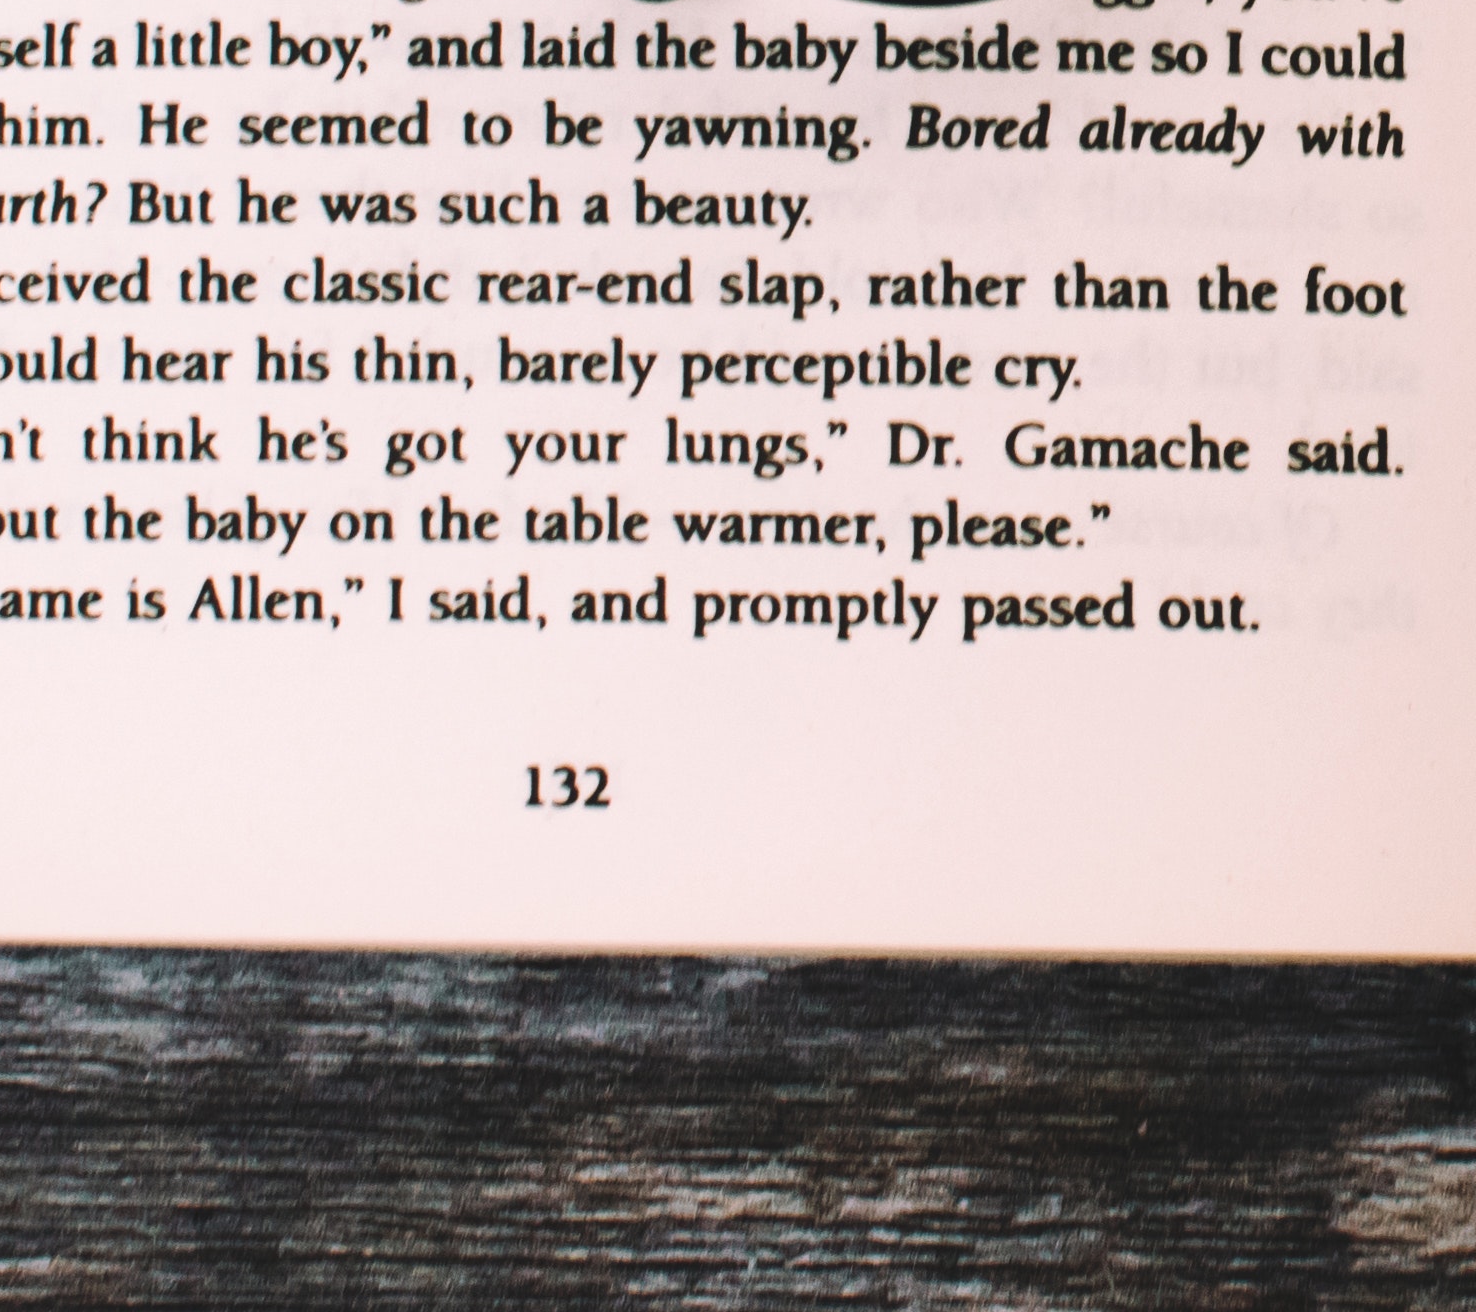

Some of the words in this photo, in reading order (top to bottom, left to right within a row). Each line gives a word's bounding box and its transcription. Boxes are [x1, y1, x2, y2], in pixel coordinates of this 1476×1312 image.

[139, 102, 208, 146] He
[239, 98, 429, 147] seemed
[463, 111, 512, 147] to
[544, 99, 603, 147] be
[634, 105, 871, 164] yawning.
[905, 101, 1051, 151] Bored
[1079, 103, 1265, 169] already
[1297, 110, 1405, 159] with
[180, 256, 257, 304] the
[283, 256, 449, 304] classic
[477, 257, 693, 306] rear-end
[720, 257, 839, 322] slap,
[868, 259, 1027, 309] rather
[1054, 260, 1170, 311] than
[1198, 263, 1278, 314] the
[1305, 264, 1408, 318] foot
[122, 335, 233, 383] hear
[256, 335, 330, 383] his
[354, 334, 473, 391] thin,
[498, 335, 657, 399] barely
[680, 337, 971, 401] perceptible
[994, 354, 1081, 403] cry.
[127, 578, 166, 621] is
[188, 574, 364, 630] Allen,”
[389, 577, 403, 622] I
[429, 573, 547, 631] said,
[571, 575, 668, 624] and
[693, 577, 939, 642] promptly
[962, 579, 1136, 644] passed
[1159, 593, 1259, 633] out.
[527, 766, 611, 808] 132
